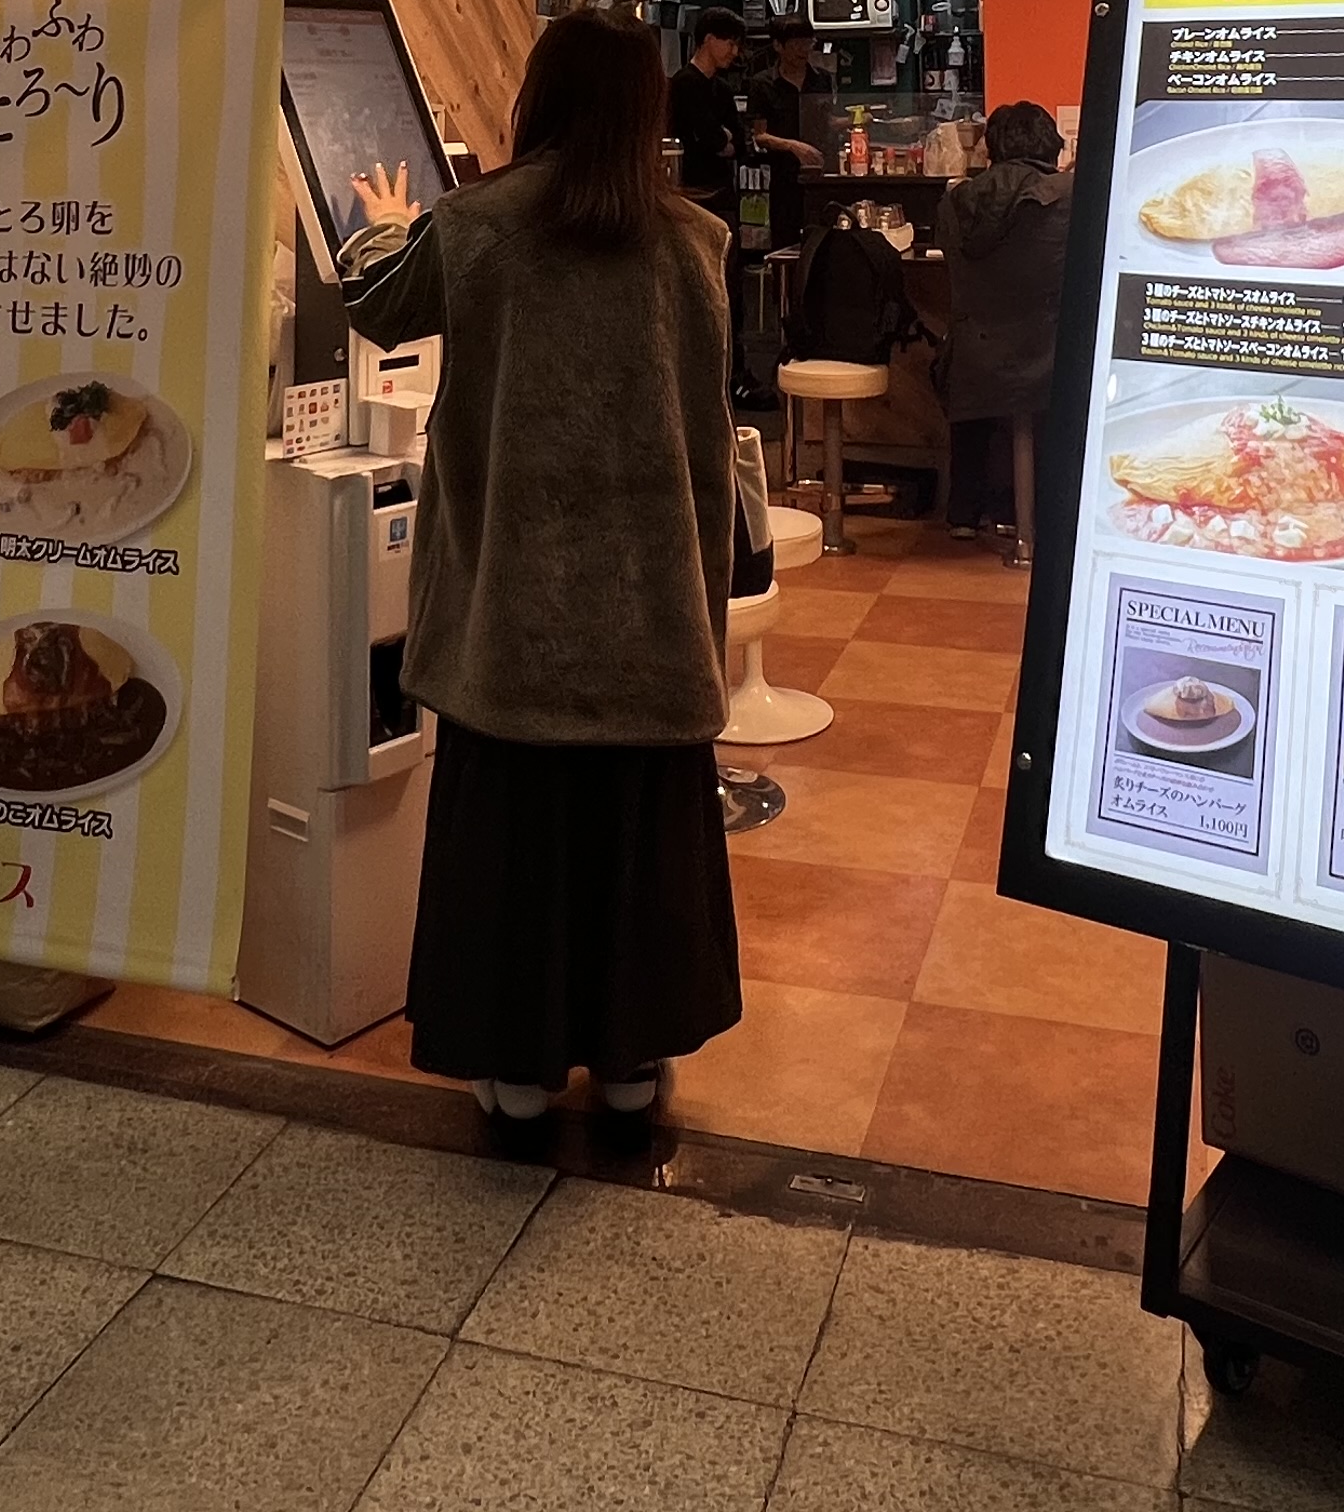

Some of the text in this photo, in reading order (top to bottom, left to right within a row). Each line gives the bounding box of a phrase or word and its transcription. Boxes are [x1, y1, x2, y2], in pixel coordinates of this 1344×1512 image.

[1169, 49, 1266, 64] チキンオムライス
[1167, 72, 1277, 86] ベーコンオムライス
[0, 534, 180, 575] 明太クリームオムライス
[1126, 599, 1207, 628] SPECIAL
[1208, 613, 1266, 638] MENU
[1111, 792, 1168, 818] オムライス
[1199, 814, 1249, 839] 1,100円
